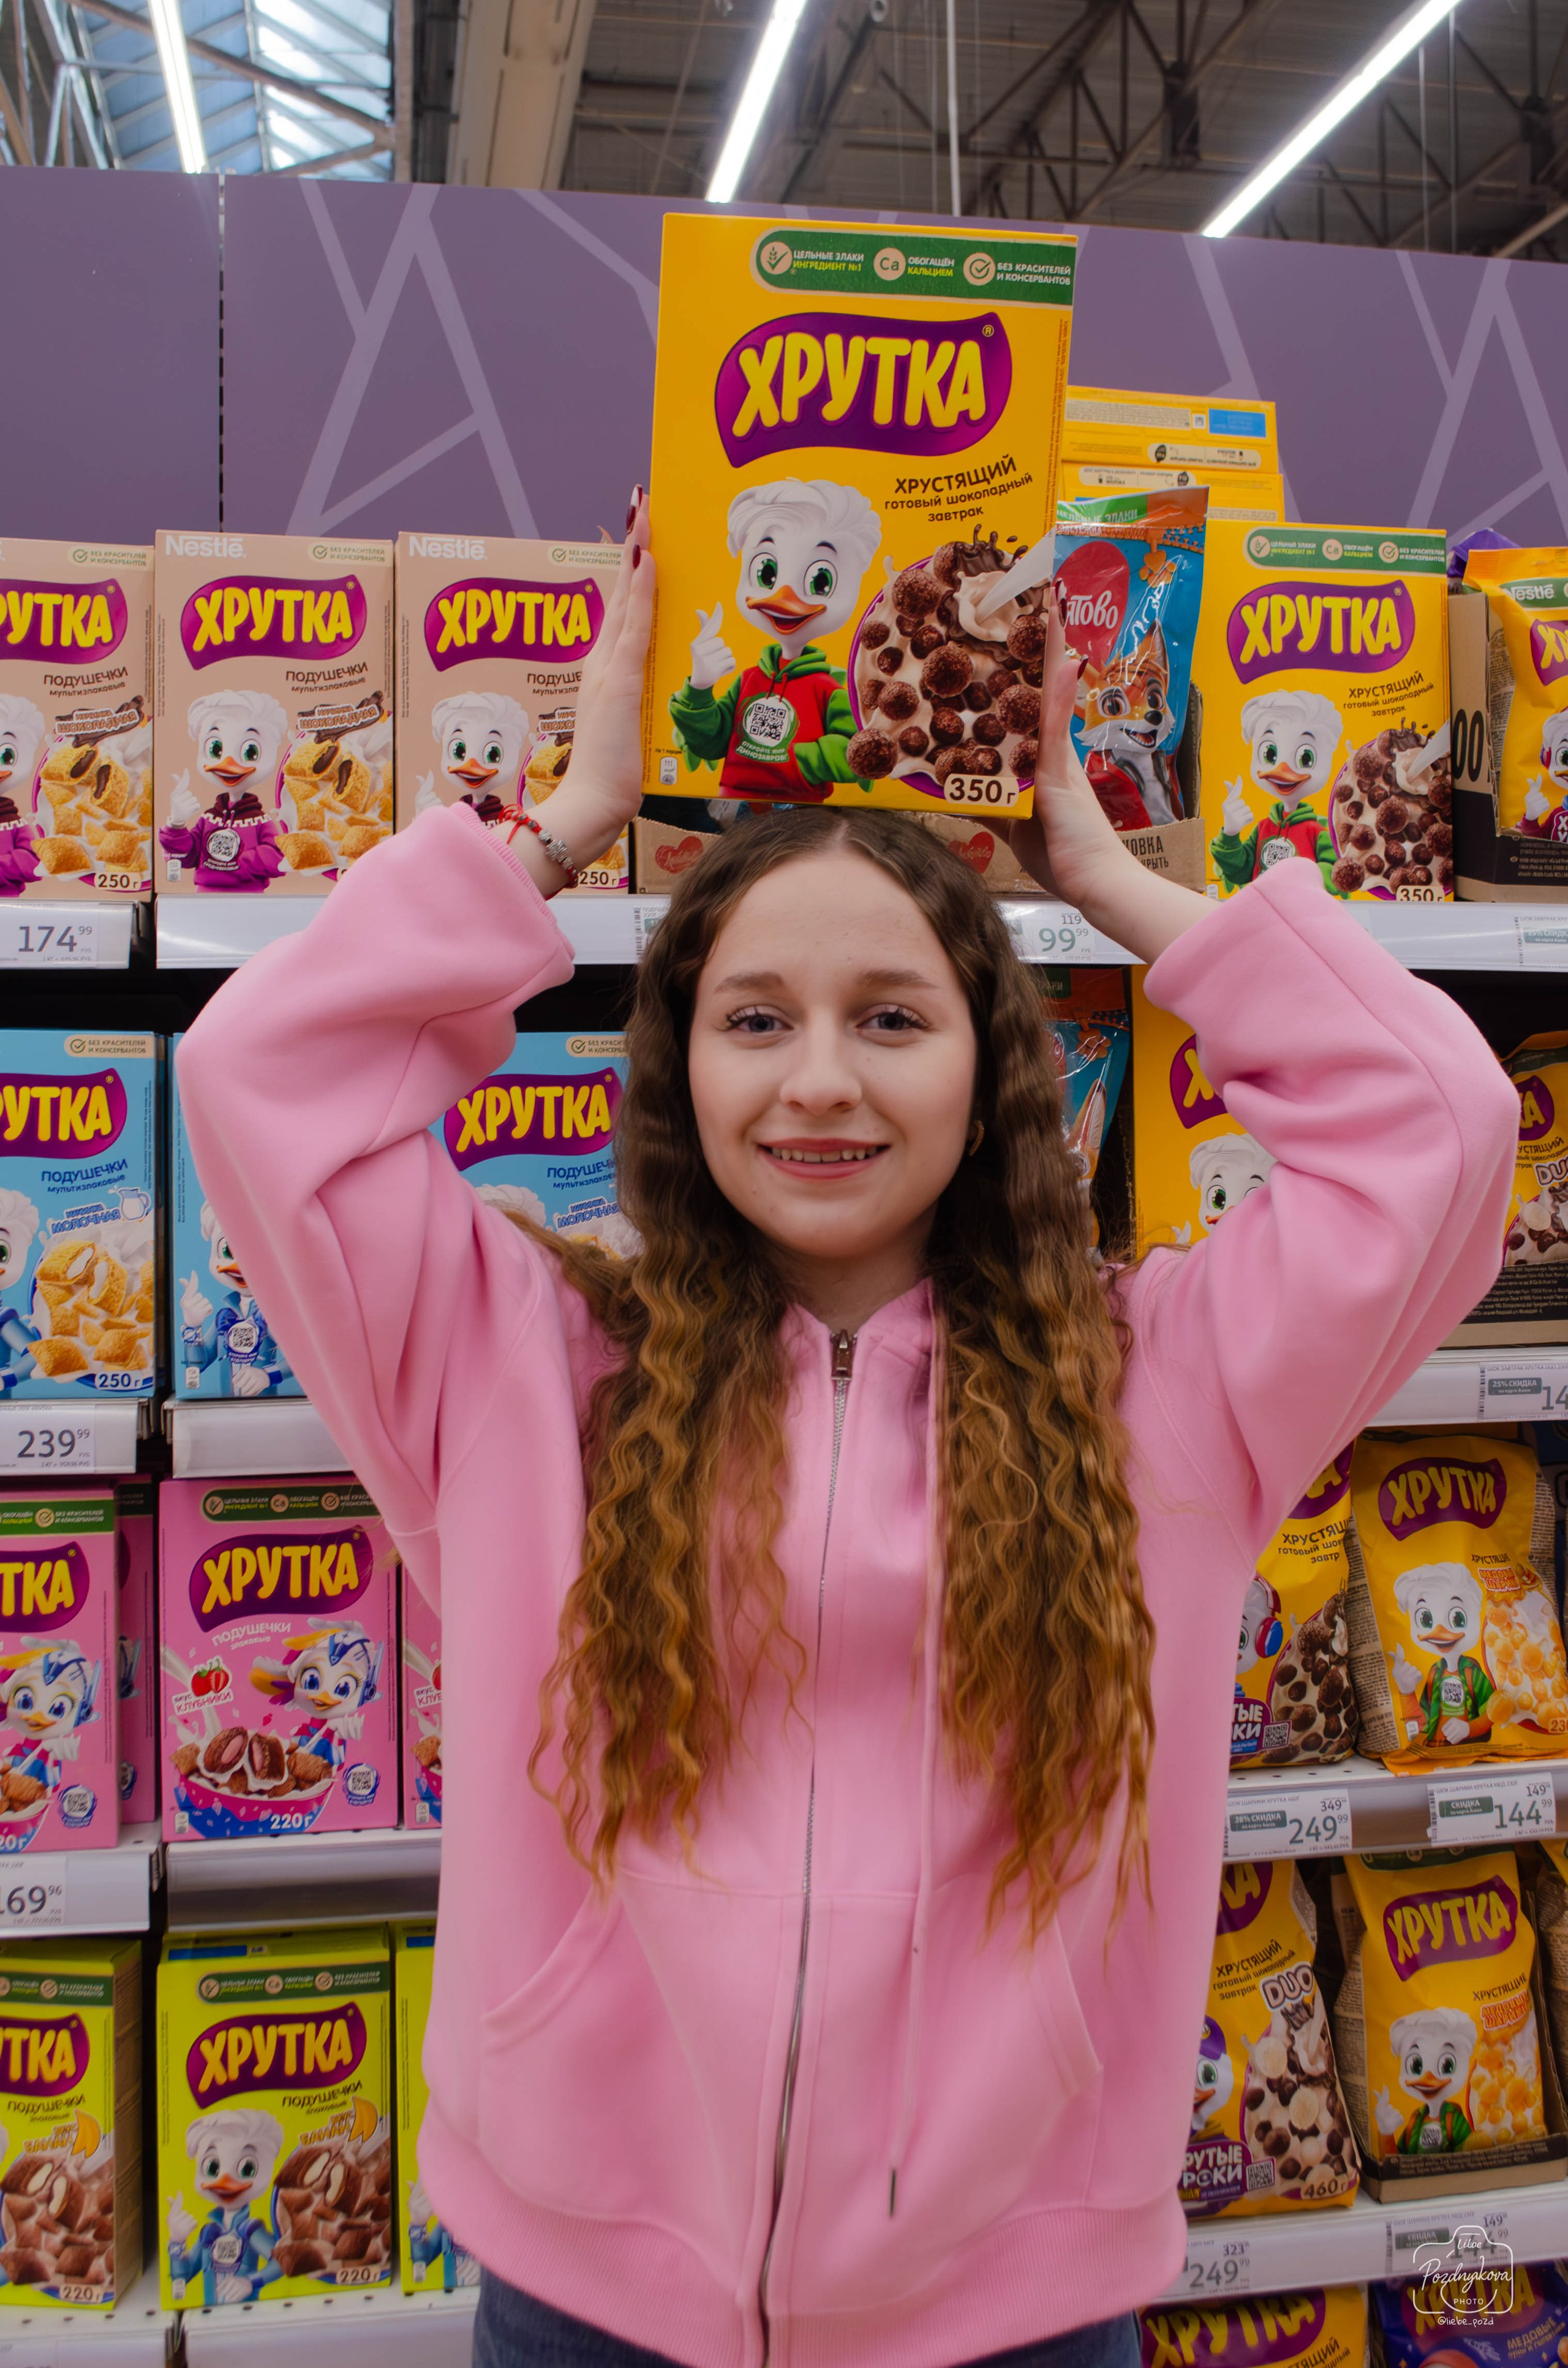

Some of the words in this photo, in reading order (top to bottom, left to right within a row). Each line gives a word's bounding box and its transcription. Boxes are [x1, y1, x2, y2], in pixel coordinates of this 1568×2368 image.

[793, 260, 846, 271] ИНГРЕДИЕНТ
[794, 250, 833, 260] ЦЕЛЬНЫЕ
[835, 252, 864, 262] ЗЛАКИ
[908, 256, 954, 267] ОБОГАЩЁН
[907, 267, 953, 277] КАЛЬЦИЕМ
[997, 262, 1012, 271] БЕЗ
[1015, 263, 1071, 276] КРАСИТЕЛЕЙ
[997, 273, 1003, 281] И
[1005, 273, 1070, 286] КОНСЕРВАНТОВ
[732, 332, 987, 437] ХРУТКА
[895, 454, 1017, 494] ХРУСТЯЩИЙ
[884, 495, 941, 510] готовый
[946, 472, 1033, 505] шоколадный
[927, 506, 984, 521] завтрак
[1105, 509, 1138, 523] ЗЛАКИ
[0, 589, 113, 648] УТКА
[192, 587, 353, 652] ХРУТКА
[436, 588, 591, 654] ХРУТКА
[1239, 594, 1402, 665] ХРУТКА
[43, 667, 128, 688] ПОДУШЕЧКИ
[285, 662, 369, 684] ПОДУШЕЧКИ
[527, 671, 582, 687] ПОДУШЕ
[1349, 670, 1424, 698] ХРУСТЯЩИЙ
[50, 682, 126, 698] мультизлаковые
[291, 677, 366, 694] мультизлаковые
[532, 686, 580, 697] мультизла
[1343, 698, 1379, 709] готовый
[1382, 683, 1434, 705] шоколадный
[58, 711, 138, 733] ШОКОЛАДНАЯ
[300, 706, 378, 729] ШОКОЛАДНАЯ
[1371, 705, 1406, 717] завтрак
[949, 777, 1003, 804] 350
[1006, 792, 1016, 804] г
[1122, 836, 1164, 857] ОВКА
[1141, 857, 1169, 870] РЫТЬ
[98, 874, 129, 888] 250
[133, 880, 138, 888] г
[579, 871, 609, 886] 250
[1400, 888, 1434, 902] 350
[1061, 915, 1082, 925] 119
[18, 925, 78, 953] 174
[78, 925, 92, 936] 99
[1039, 928, 1076, 952] 99
[1544, 929, 1568, 937] СКИДК
[0, 1085, 113, 1141] УТКА
[456, 1084, 611, 1152] ХРУТКА
[1518, 1136, 1565, 1154] УСТЯЩИЙ
[41, 1158, 129, 1184] ПОДУШЕЧКИ
[1536, 1156, 1568, 1186] DU
[47, 1174, 126, 1194] мультизлаковые
[51, 1209, 121, 1234] МОЛОЧНАЯ
[99, 1373, 131, 1388] 250
[1509, 1379, 1537, 1388] СКИДКА
[17, 1429, 77, 1458] 239
[77, 1428, 90, 1440] 99
[1388, 1466, 1496, 1526] ХРУТКА
[1282, 1519, 1347, 1546] ХРУСТЯЩ
[1278, 1544, 1319, 1556] готовый
[1311, 1552, 1340, 1564] завтр
[0, 1558, 75, 1616] ТКА
[202, 1541, 359, 1614] ХРУТКА
[212, 1622, 292, 1647] ПОДУШЕЧКИ
[1526, 1785, 1547, 1797] 149
[1320, 1799, 1342, 1812] 349
[1450, 1799, 1480, 1809] СКИДКА
[1494, 1800, 1542, 1829] 144
[1541, 1798, 1553, 1808] 99
[1251, 1812, 1282, 1823] СКИДКА
[1289, 1815, 1338, 1845] 249
[1337, 1814, 1348, 1823] 99
[0, 1885, 47, 1915] 69
[1387, 1891, 1512, 1965] ХРУТКА
[1216, 1939, 1283, 1978] ХРУСТЯЩИЙ
[1213, 1973, 1252, 1991] готовый
[1219, 1984, 1257, 2000] завтрак
[1262, 1964, 1314, 2009] DUO
[1472, 1972, 1527, 2002] ХРУСТЯЩИЕ
[0, 2026, 77, 2083] ТКА
[198, 2018, 353, 2094] ХРУТКА
[7, 2093, 86, 2116] ПОДУШЕЧКИ
[282, 2079, 363, 2109] ПОДУШЕЧКИ
[1184, 2145, 1243, 2170] РУТЫЕ
[1182, 2165, 1242, 2187] РОКИ
[1303, 2179, 1339, 2198] 460
[1483, 2215, 1503, 2228] 149
[341, 2268, 371, 2283] 220
[1189, 2260, 1238, 2288] 249
[63, 2286, 93, 2300] 220
[1406, 2265, 1536, 2336] ХРУТКА
[1146, 2294, 1316, 2368] ХРУТКА
[1507, 2316, 1556, 2350] МЕДОВЫЕ
